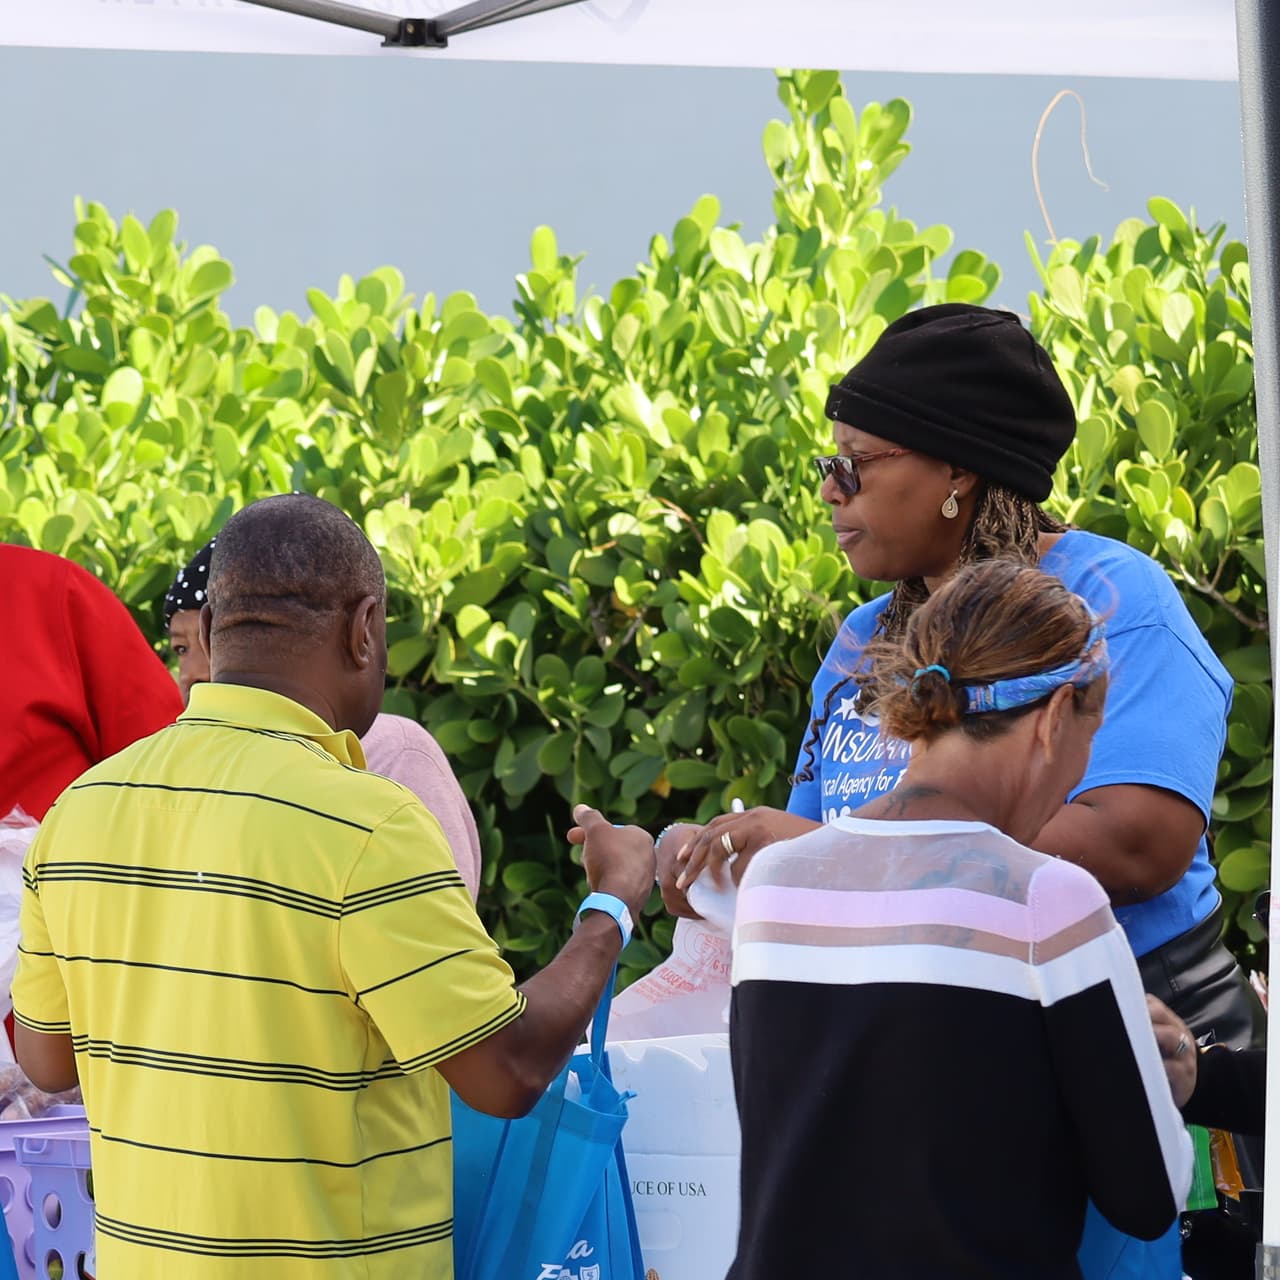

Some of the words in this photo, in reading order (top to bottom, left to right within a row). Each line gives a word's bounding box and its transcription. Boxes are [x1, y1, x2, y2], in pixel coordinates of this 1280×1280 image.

[837, 772, 875, 801] Agency
[875, 768, 894, 791] for
[657, 1181, 675, 1196] OF
[679, 1182, 707, 1197] USA
